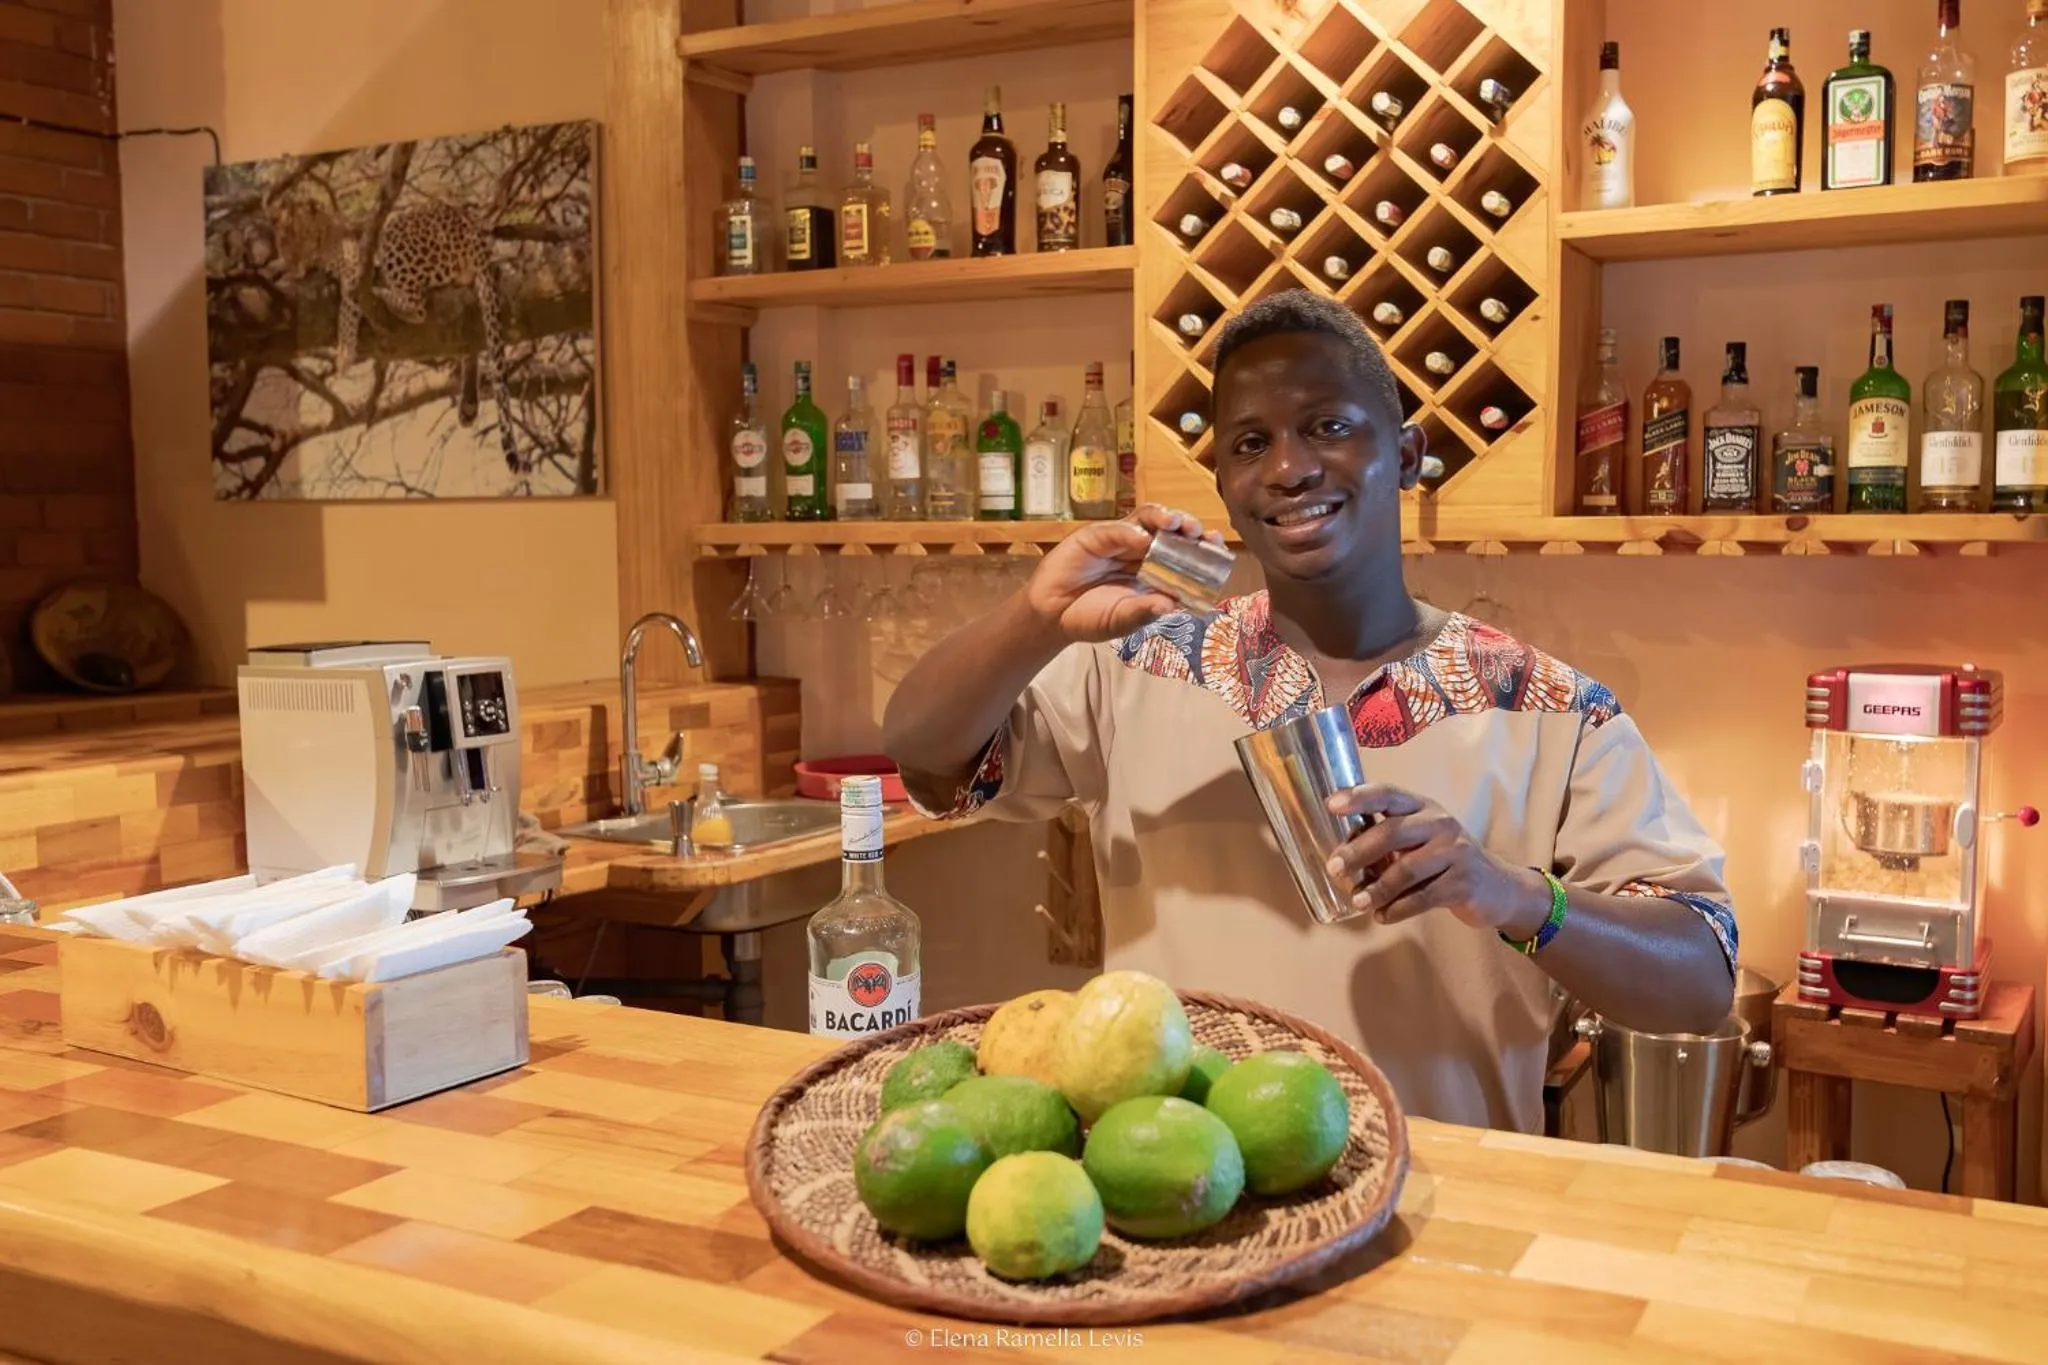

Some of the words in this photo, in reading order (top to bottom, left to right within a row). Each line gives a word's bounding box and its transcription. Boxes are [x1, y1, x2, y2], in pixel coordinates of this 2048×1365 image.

[1853, 403, 1905, 418] JAMESON
[1863, 704, 1921, 716] GEEPAS
[848, 851, 868, 860] WHITE
[825, 1000, 911, 1031] BACARDÍ
